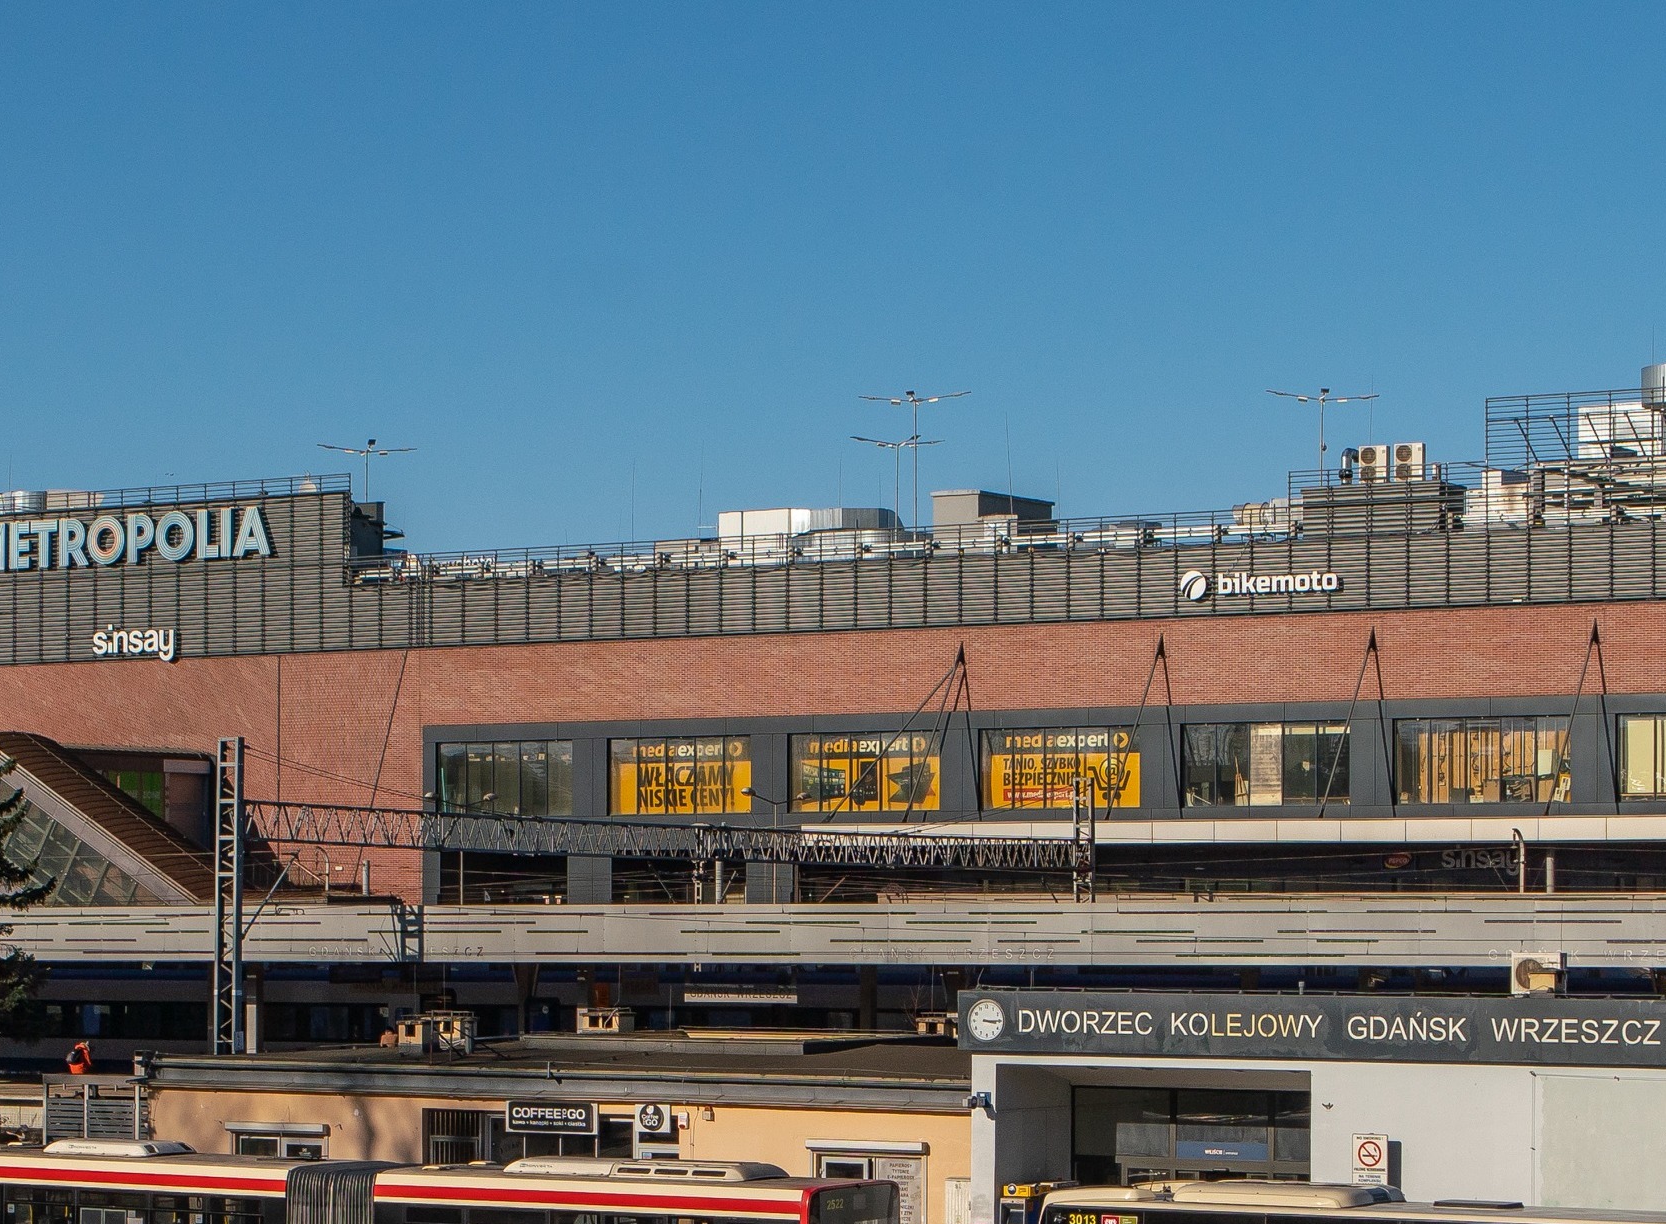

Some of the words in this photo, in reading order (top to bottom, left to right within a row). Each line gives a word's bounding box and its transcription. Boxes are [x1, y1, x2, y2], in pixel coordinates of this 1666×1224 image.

[1218, 573, 1338, 595] bikemoto
[92, 624, 175, 662] sinsay
[633, 743, 722, 762] medaexpert
[809, 737, 908, 760] mediaexpert
[1006, 734, 1108, 751] medaexpert
[638, 788, 687, 808] NISKIE
[690, 787, 736, 807] CENY!
[947, 948, 1056, 960] WRZESZCZ
[1018, 1009, 1153, 1036] DWORZEC
[1171, 1012, 1324, 1039] KOLEJOWY
[1347, 1011, 1467, 1042] GDAŃSK
[1491, 1017, 1662, 1046] WRZESZCZ
[512, 1107, 562, 1120] COFFEE
[567, 1108, 586, 1120] GO
[826, 1198, 844, 1211] 2522
